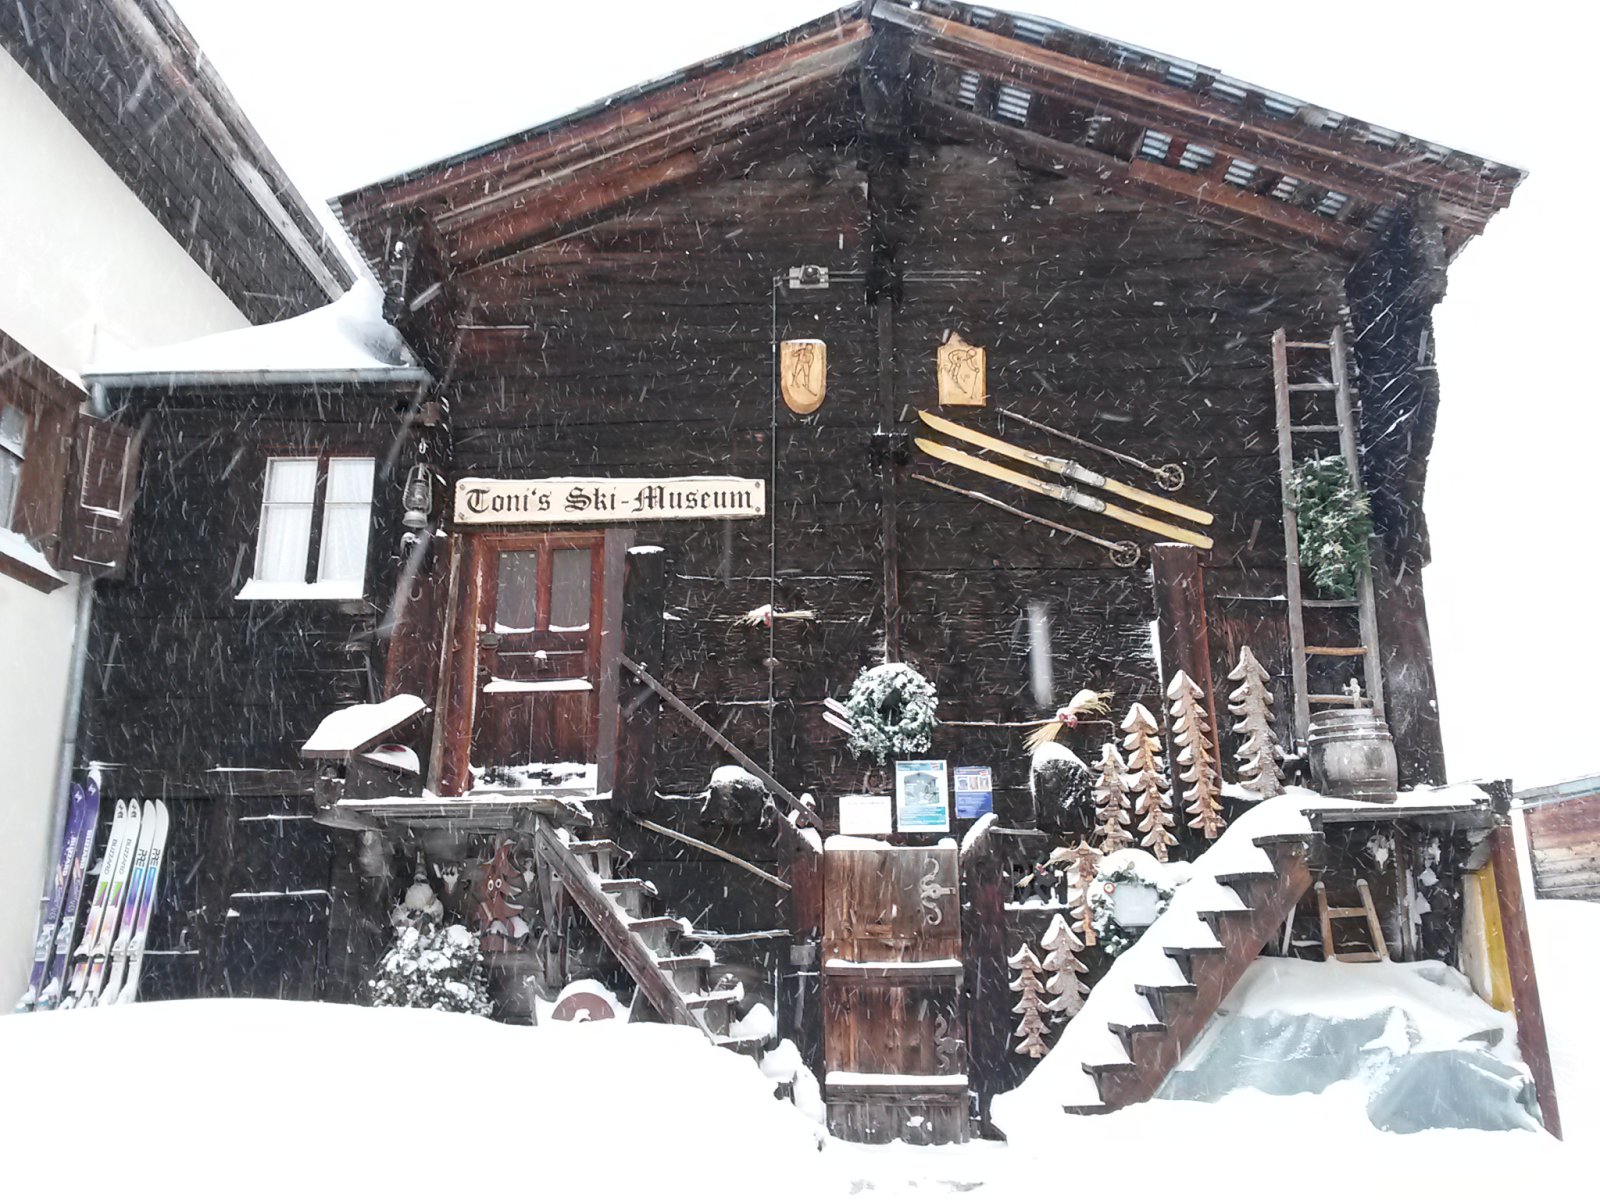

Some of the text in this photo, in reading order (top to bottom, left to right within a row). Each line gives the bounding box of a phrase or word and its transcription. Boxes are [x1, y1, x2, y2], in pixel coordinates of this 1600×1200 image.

[564, 484, 754, 514] Ski-Museum
[62, 836, 77, 877] BLIZZARD
[80, 829, 93, 869] BLIZZARD
[104, 838, 118, 875] BLIZZARD
[119, 838, 132, 875] BLIZZARD
[135, 848, 148, 867] PRE
[149, 848, 161, 866] PRE
